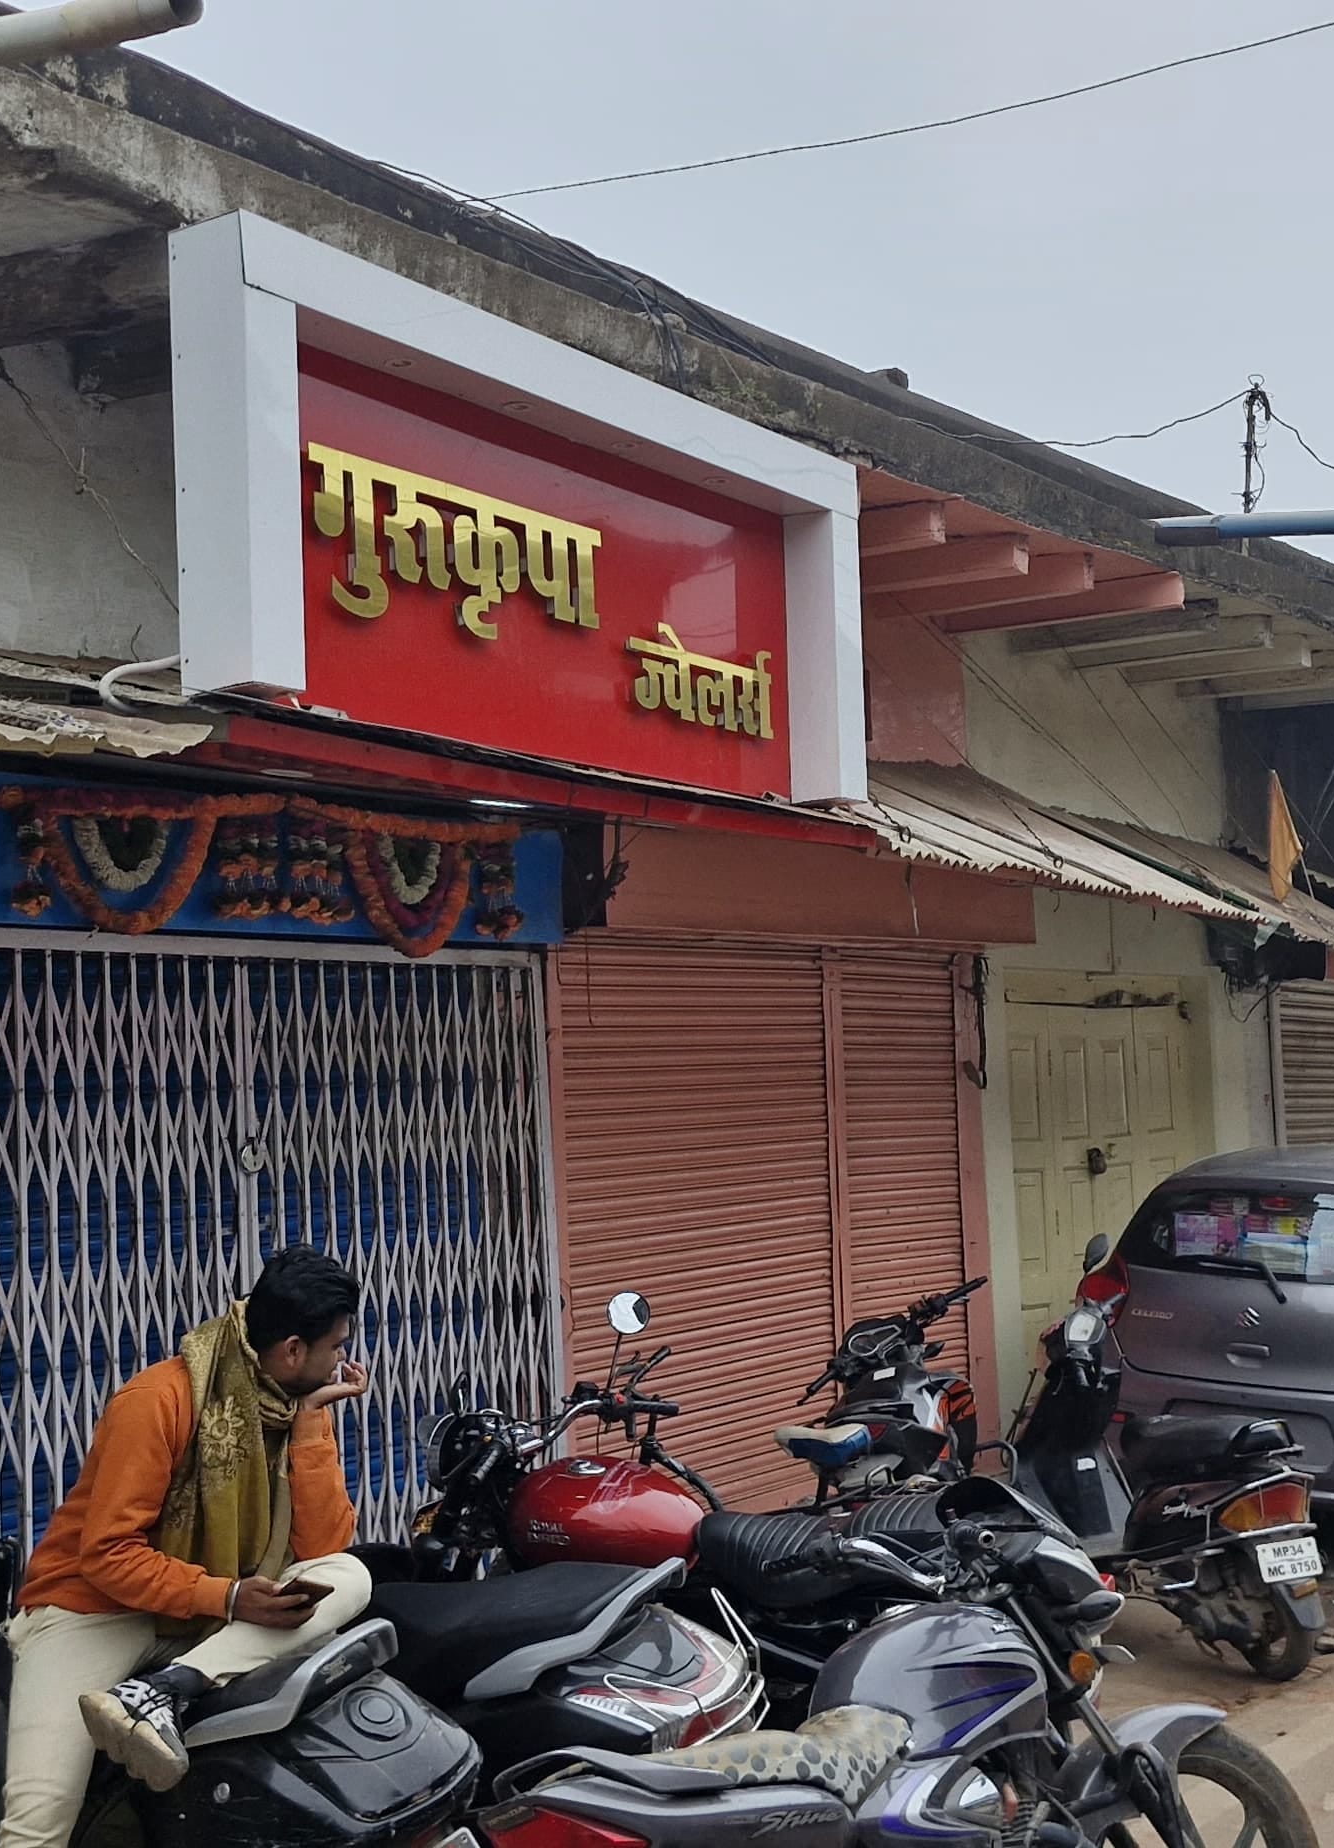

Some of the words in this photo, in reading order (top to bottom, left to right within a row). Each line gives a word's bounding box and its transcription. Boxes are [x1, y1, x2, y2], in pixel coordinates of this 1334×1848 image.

[308, 441, 603, 639] गुरुकृपा
[627, 622, 774, 738] ज्वेलर्स
[1272, 1544, 1304, 1558] MP34
[1268, 1564, 1286, 1577] MC
[1290, 1560, 1318, 1575] 8750
[748, 1809, 844, 1839] Shine
